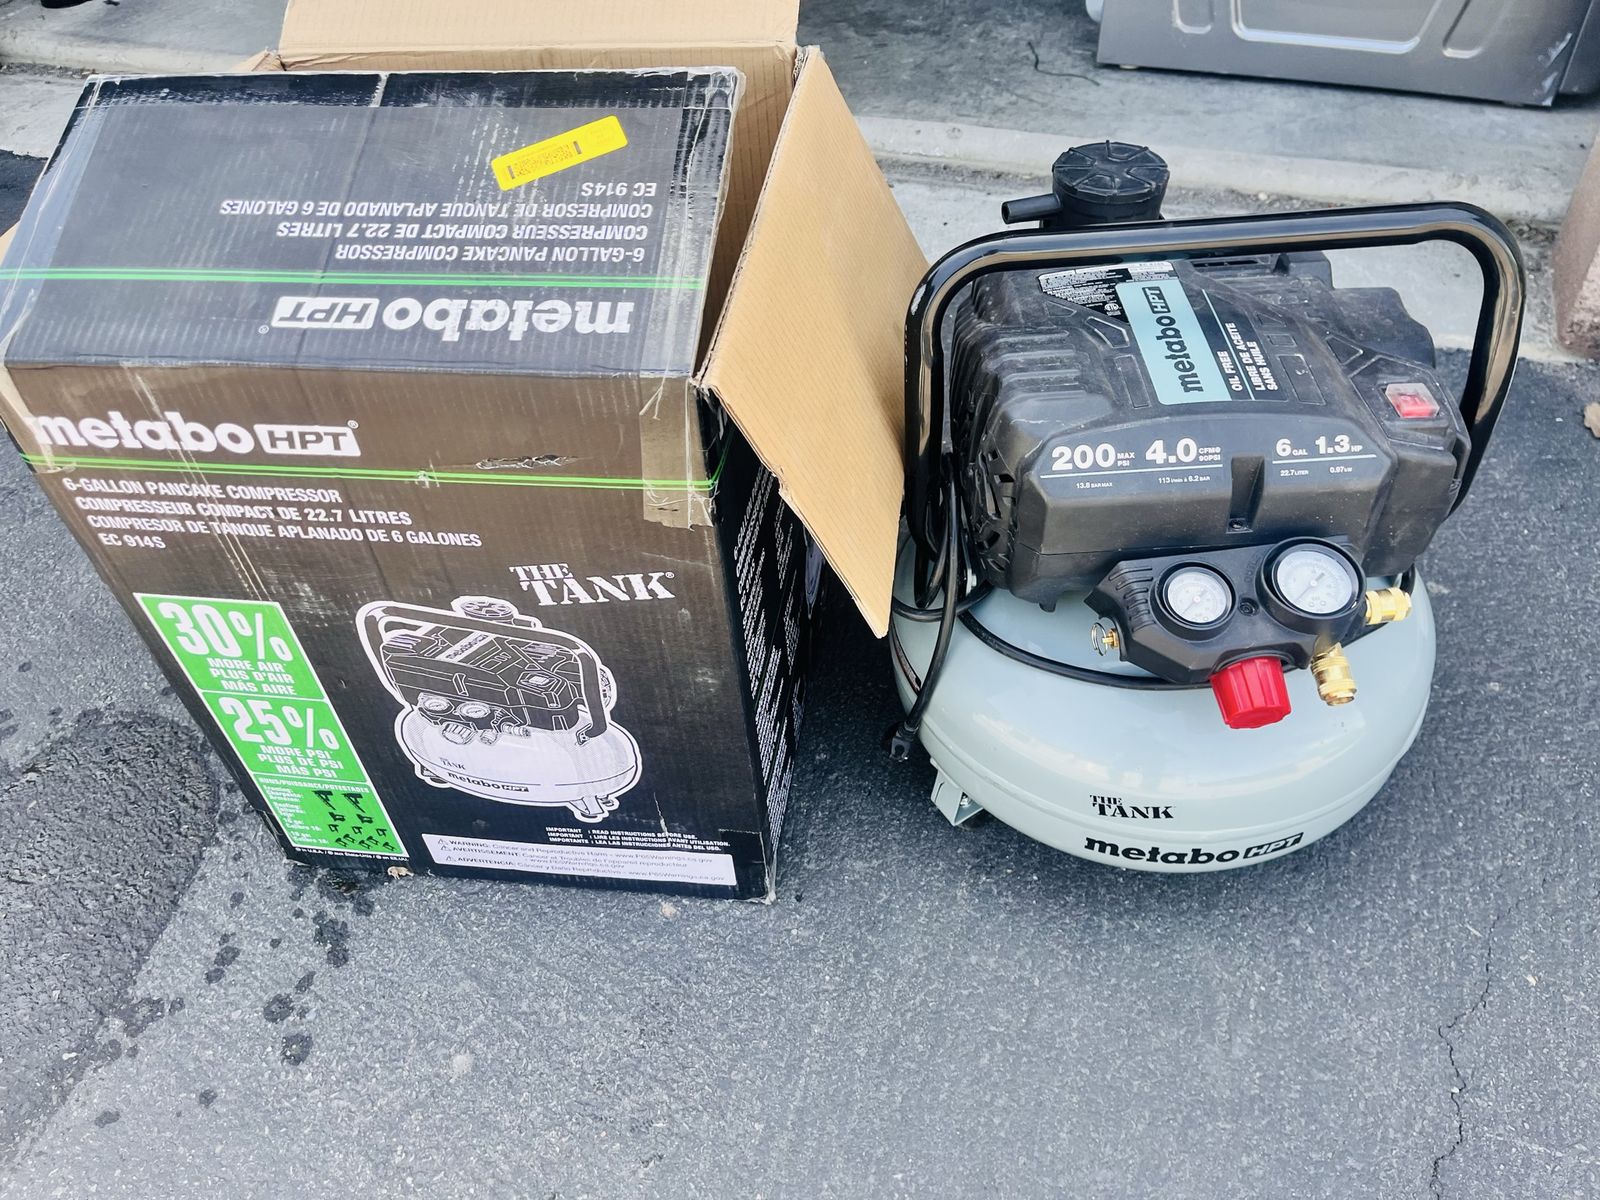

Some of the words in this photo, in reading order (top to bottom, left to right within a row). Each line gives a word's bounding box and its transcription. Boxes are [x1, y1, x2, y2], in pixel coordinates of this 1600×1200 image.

[581, 182, 628, 198] 914S
[633, 182, 656, 197] EC
[221, 199, 299, 215] GALONES
[303, 200, 315, 215] 6
[318, 201, 341, 216] DE
[344, 201, 437, 217] APLANADO
[441, 202, 510, 218] TANQUE
[516, 202, 538, 218] DE
[542, 203, 653, 219] COMPRESOR
[277, 221, 343, 238] LITRES
[350, 222, 391, 238] 22.7
[396, 223, 420, 239] DE
[422, 223, 508, 240] COMPACT
[512, 224, 648, 241] COMPRESSEUR
[335, 244, 459, 260] COMPRESSOR
[464, 244, 547, 262] PANCAKE
[552, 244, 645, 263] 6-GALLON
[1142, 286, 1171, 314] HPT
[383, 297, 635, 341] metabo
[1155, 315, 1204, 393] metabo
[1240, 352, 1254, 365] DE
[1246, 341, 1267, 366] HUILE
[1217, 351, 1236, 374] FREE
[1228, 375, 1243, 391] OIL
[1246, 365, 1266, 390] LIBRE
[1259, 367, 1279, 391] SANS
[36, 411, 256, 453] metabo
[1145, 437, 1198, 464] 4.0
[1276, 438, 1291, 457] 6
[1315, 434, 1350, 454] 1.3
[1051, 443, 1116, 471] 200
[1117, 452, 1136, 460] MAX
[62, 478, 146, 495] 6-GALLON
[145, 481, 226, 499] PANCAKE
[226, 485, 342, 503] COMPRESSOR
[75, 496, 196, 516] COMPRESSEUR
[197, 502, 274, 520] COMPACT
[277, 507, 302, 521] DE
[304, 508, 343, 523] 22.7
[349, 509, 413, 526] LITRES
[87, 515, 186, 533] COMPRESOR
[185, 520, 210, 535] DE
[210, 522, 276, 538] TANQUE
[279, 525, 364, 542] APLANADO
[364, 528, 391, 543] DE
[390, 530, 404, 543] 6
[405, 531, 482, 547] GALONES
[122, 535, 166, 549] 914S
[509, 563, 574, 580] THE
[157, 601, 294, 661] 30%
[207, 658, 255, 671] MORE
[209, 668, 250, 681] PLUS
[253, 671, 295, 684] D'AIR
[221, 679, 258, 693] MÁS
[261, 684, 297, 696] AIRE
[218, 697, 340, 750] 25%
[260, 745, 306, 757] MORE
[257, 753, 297, 765] PLUS
[298, 756, 317, 767] DE
[320, 758, 344, 770] PSI
[313, 767, 337, 778] PSI
[447, 772, 500, 789] metabo
[1090, 794, 1123, 805] THE
[1092, 803, 1174, 819] TANK
[546, 826, 582, 834] IMPORTANT
[610, 830, 656, 838] INSTRUCTIONS
[1084, 837, 1239, 865] metabo
[1242, 832, 1304, 859] HPT
